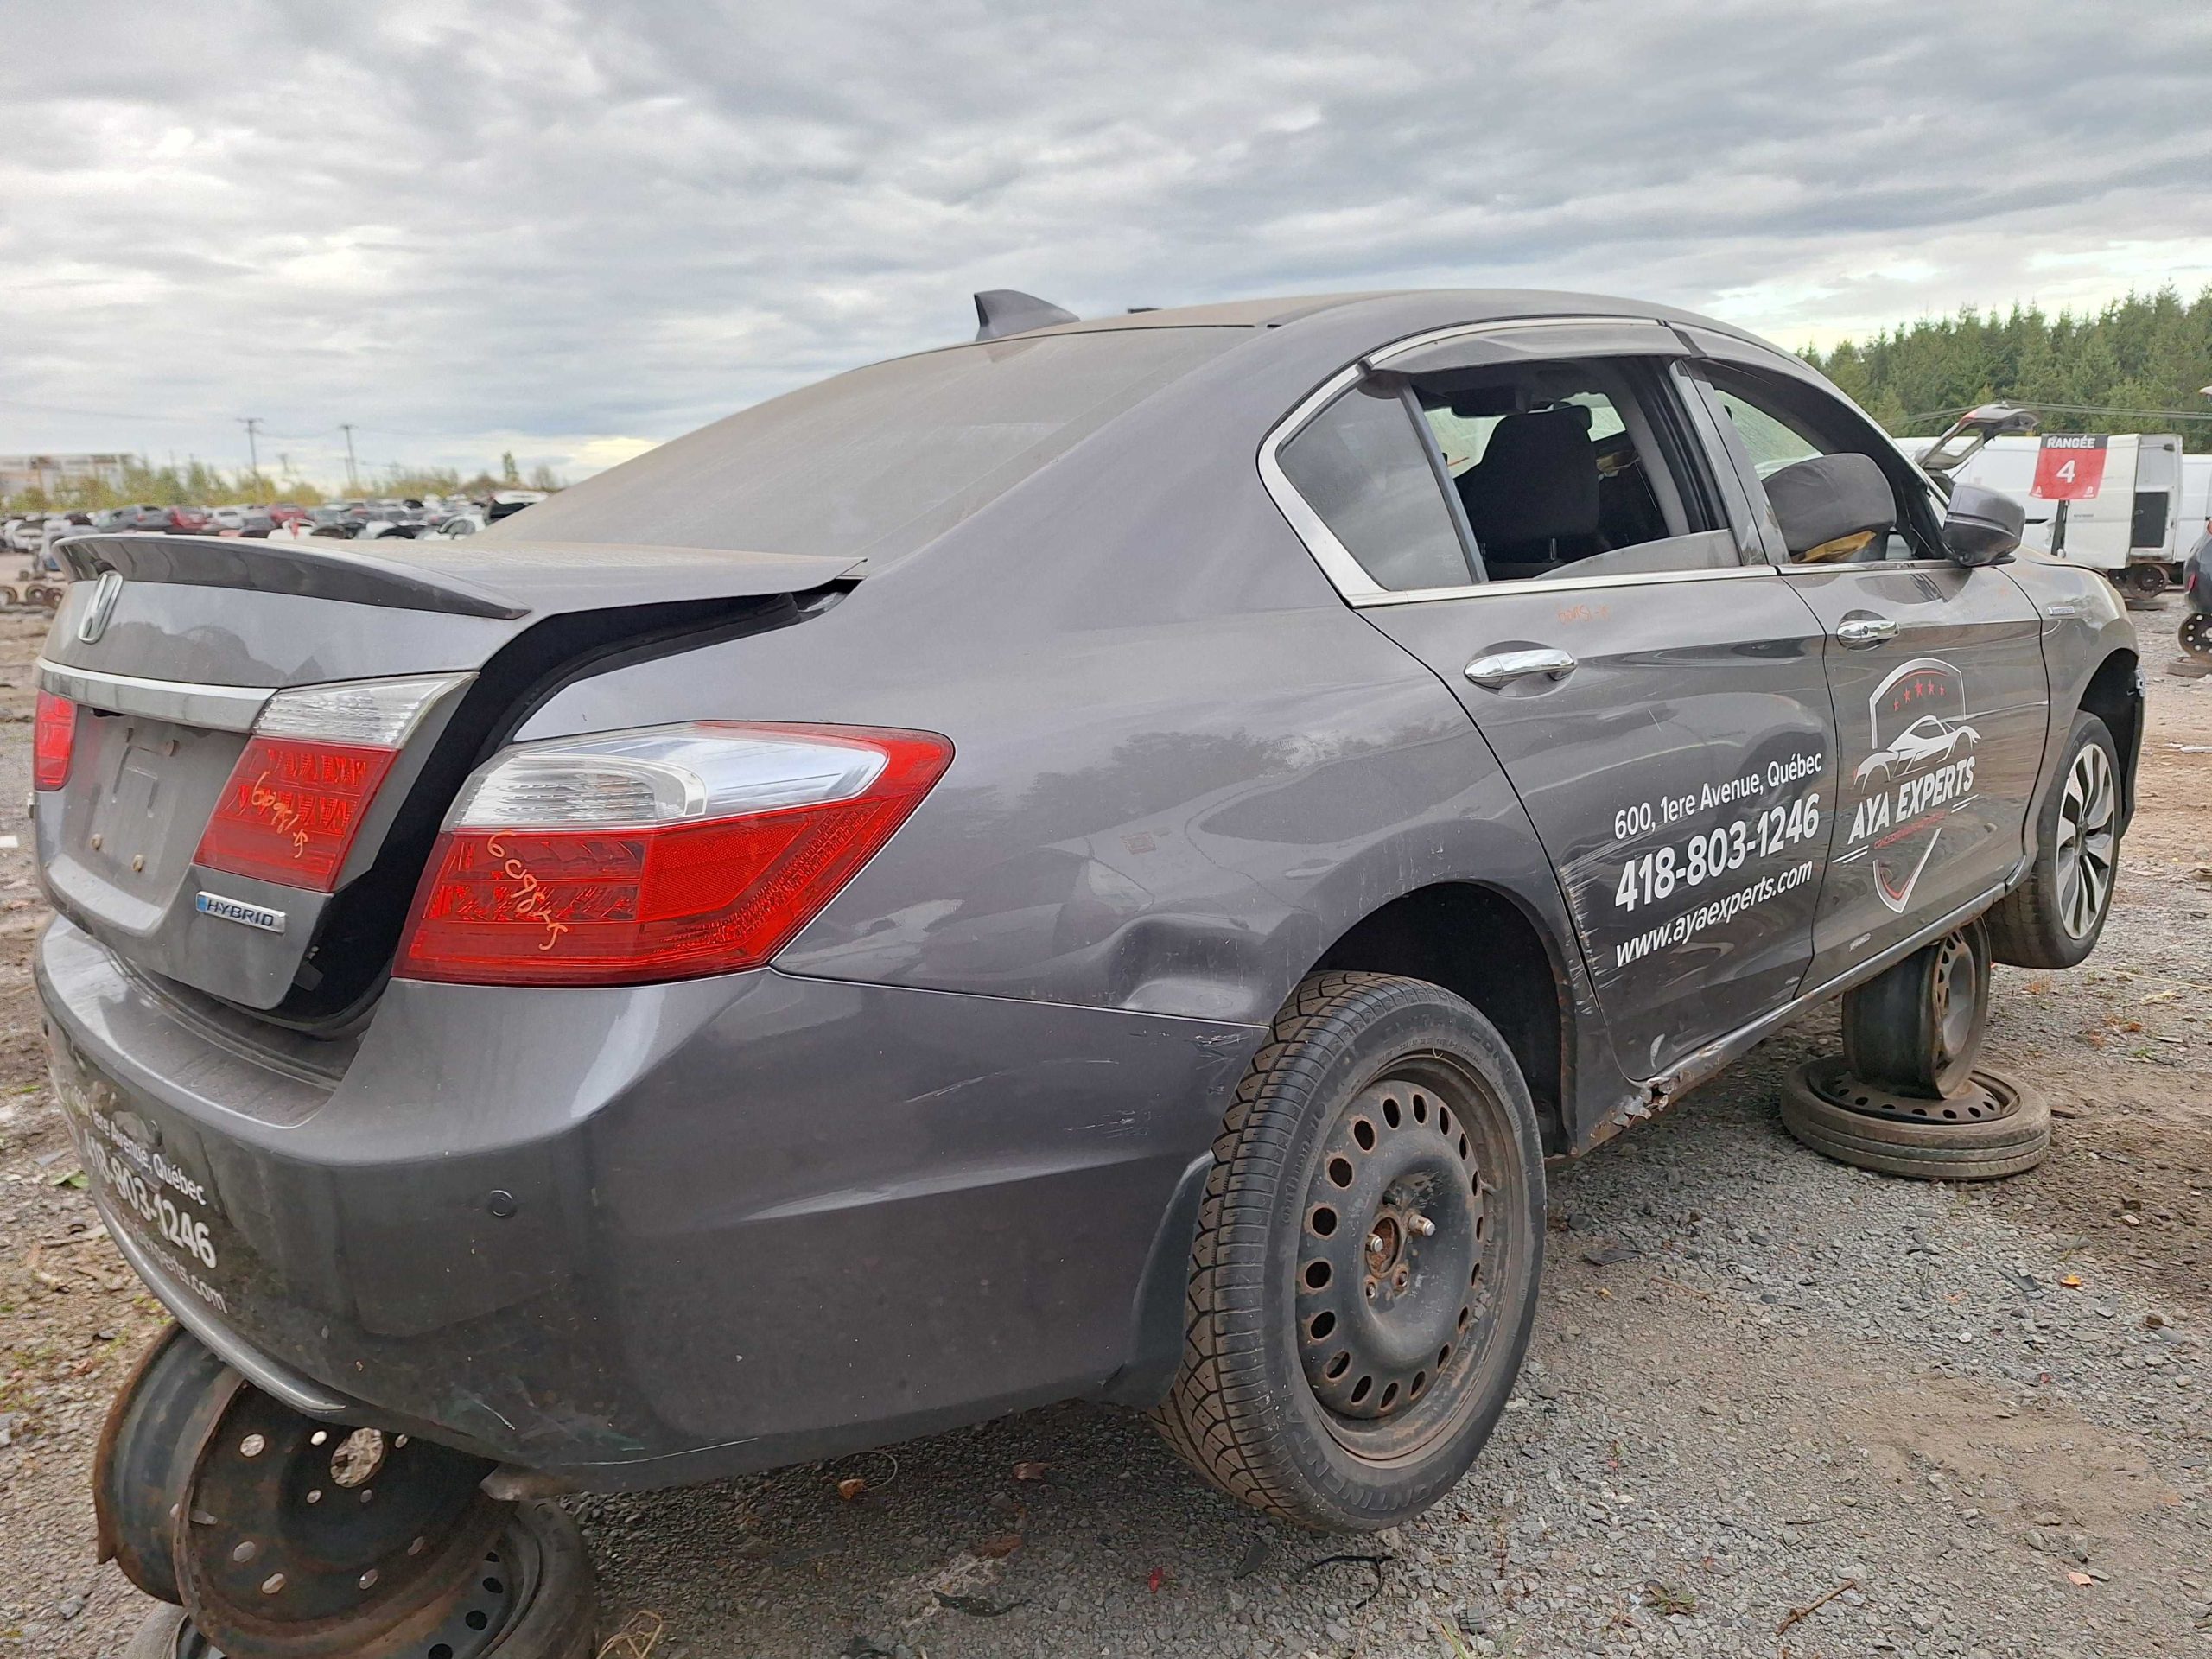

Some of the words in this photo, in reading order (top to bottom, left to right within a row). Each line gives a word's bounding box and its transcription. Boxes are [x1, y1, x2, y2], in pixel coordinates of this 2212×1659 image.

[2047, 435, 2096, 449] RANGÉE
[2056, 459, 2075, 484] 4
[1614, 802, 1656, 840] 600,
[1660, 796, 1696, 823] 1ere
[1700, 782, 1764, 811] Avenue,
[1767, 752, 1822, 788] Québec
[1847, 791, 1891, 845] AYA
[1896, 756, 1976, 823] EXPERTS
[1615, 792, 1820, 912] 418-803-1246
[207, 899, 275, 928] HYBRID
[1616, 861, 1813, 968] www.ayaexperts.com
[85, 1128, 217, 1269] 418-803-1246
[152, 1153, 207, 1206] Québec
